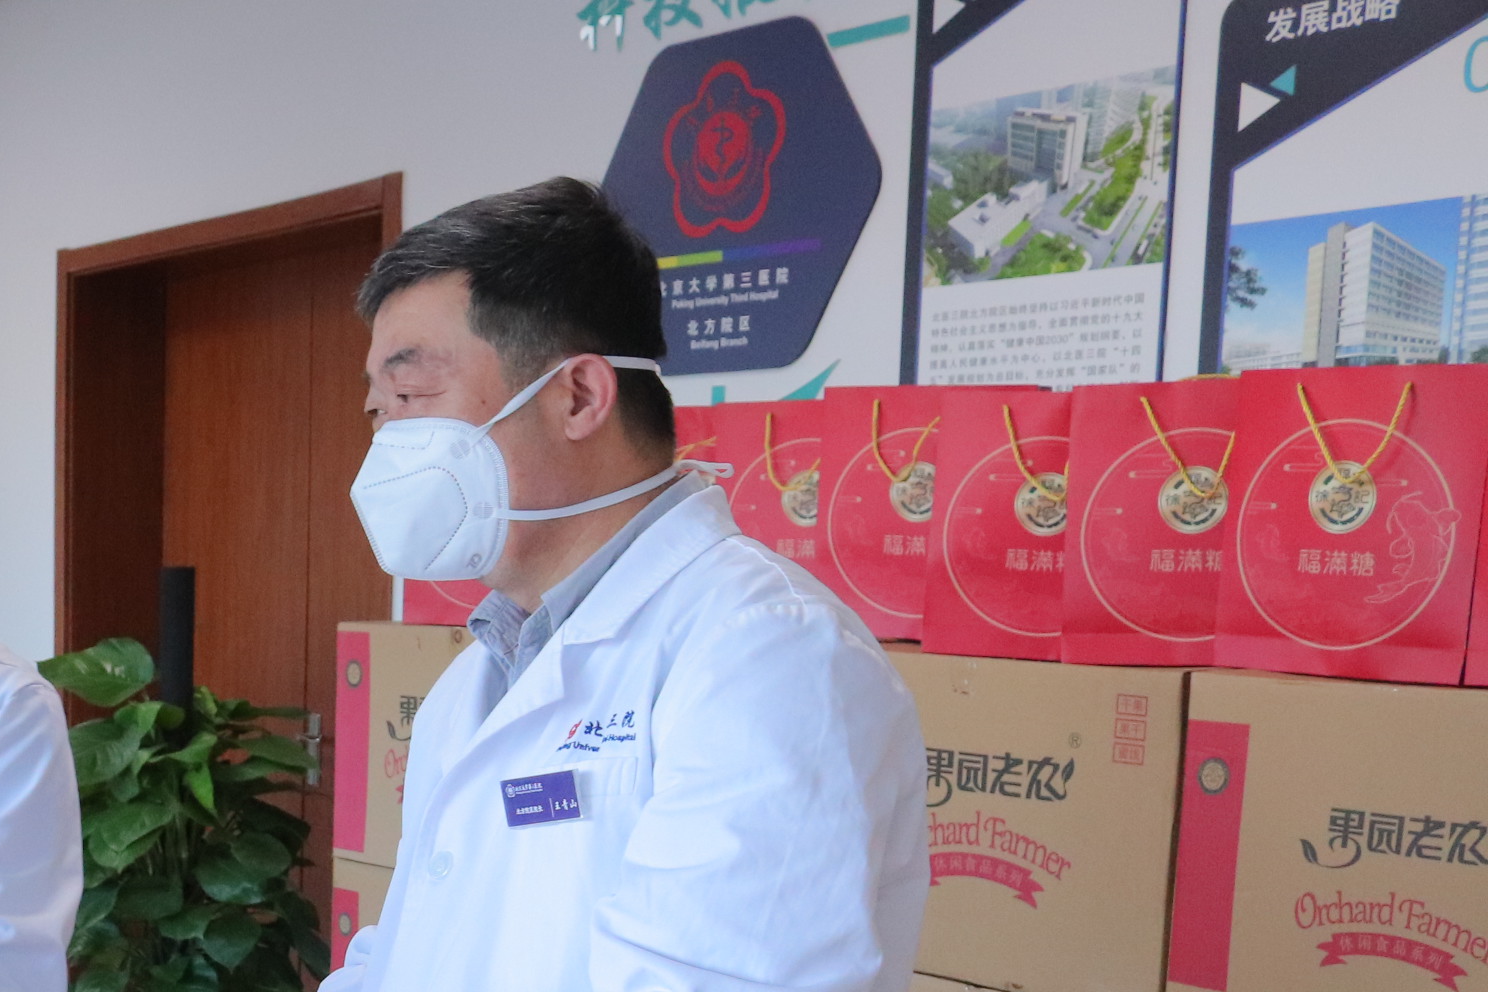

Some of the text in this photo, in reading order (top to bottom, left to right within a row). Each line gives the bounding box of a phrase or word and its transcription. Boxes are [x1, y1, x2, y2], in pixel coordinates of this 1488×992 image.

[1265, 0, 1400, 43] 发展战略
[687, 315, 750, 337] 北方院区
[926, 747, 1075, 807] 果园老农
[928, 811, 1071, 881] hard Farmer
[1300, 807, 1488, 869] 果园老农
[1295, 890, 1397, 930] Orchard
[1338, 934, 1445, 971] 休闲食品系列
